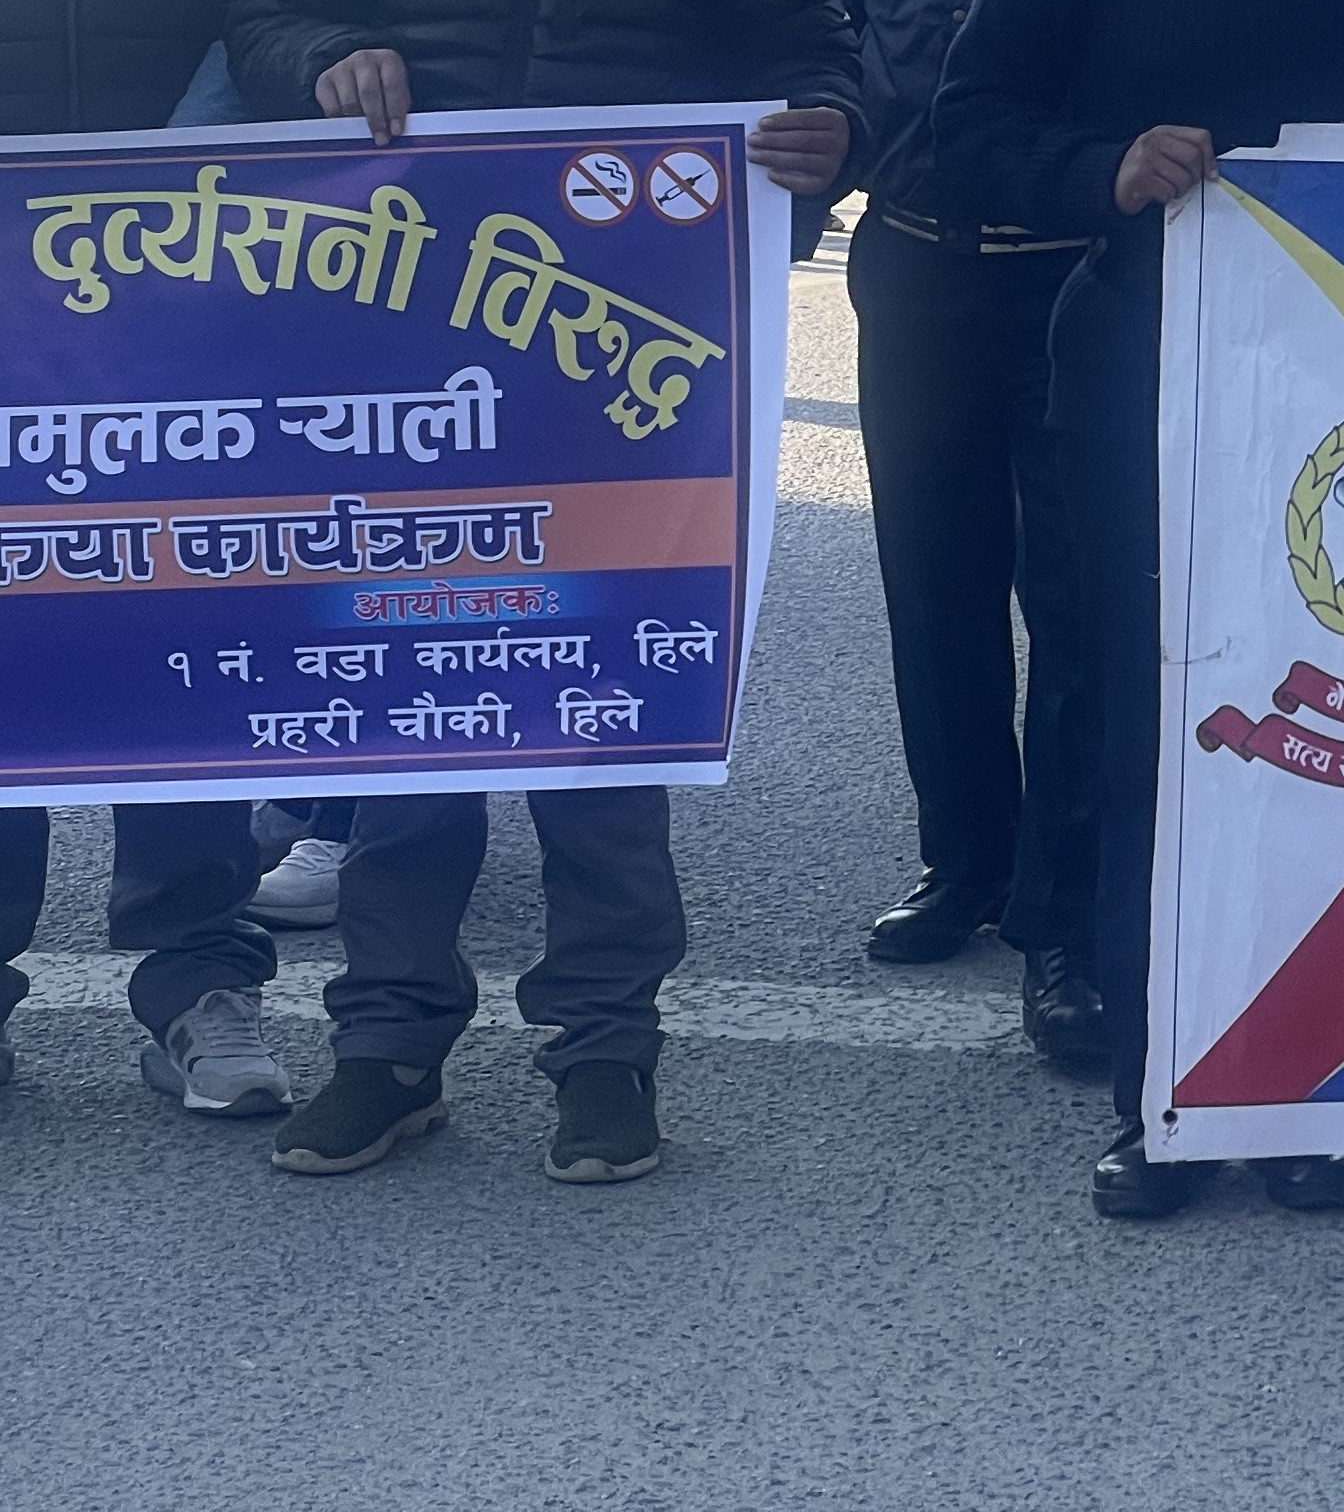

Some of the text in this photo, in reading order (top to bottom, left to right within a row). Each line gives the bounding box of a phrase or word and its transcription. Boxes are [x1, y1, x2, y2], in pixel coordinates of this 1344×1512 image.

[26, 164, 437, 314] दुर्व्यसनी
[168, 495, 553, 580] कार्यक्रम
[167, 651, 193, 688] १
[217, 640, 265, 684] नं.
[295, 643, 389, 682] वडा
[633, 620, 719, 673] हिले
[248, 688, 644, 753] प्रहरी चौकी, हिले
[1282, 733, 1334, 774] सत्य
